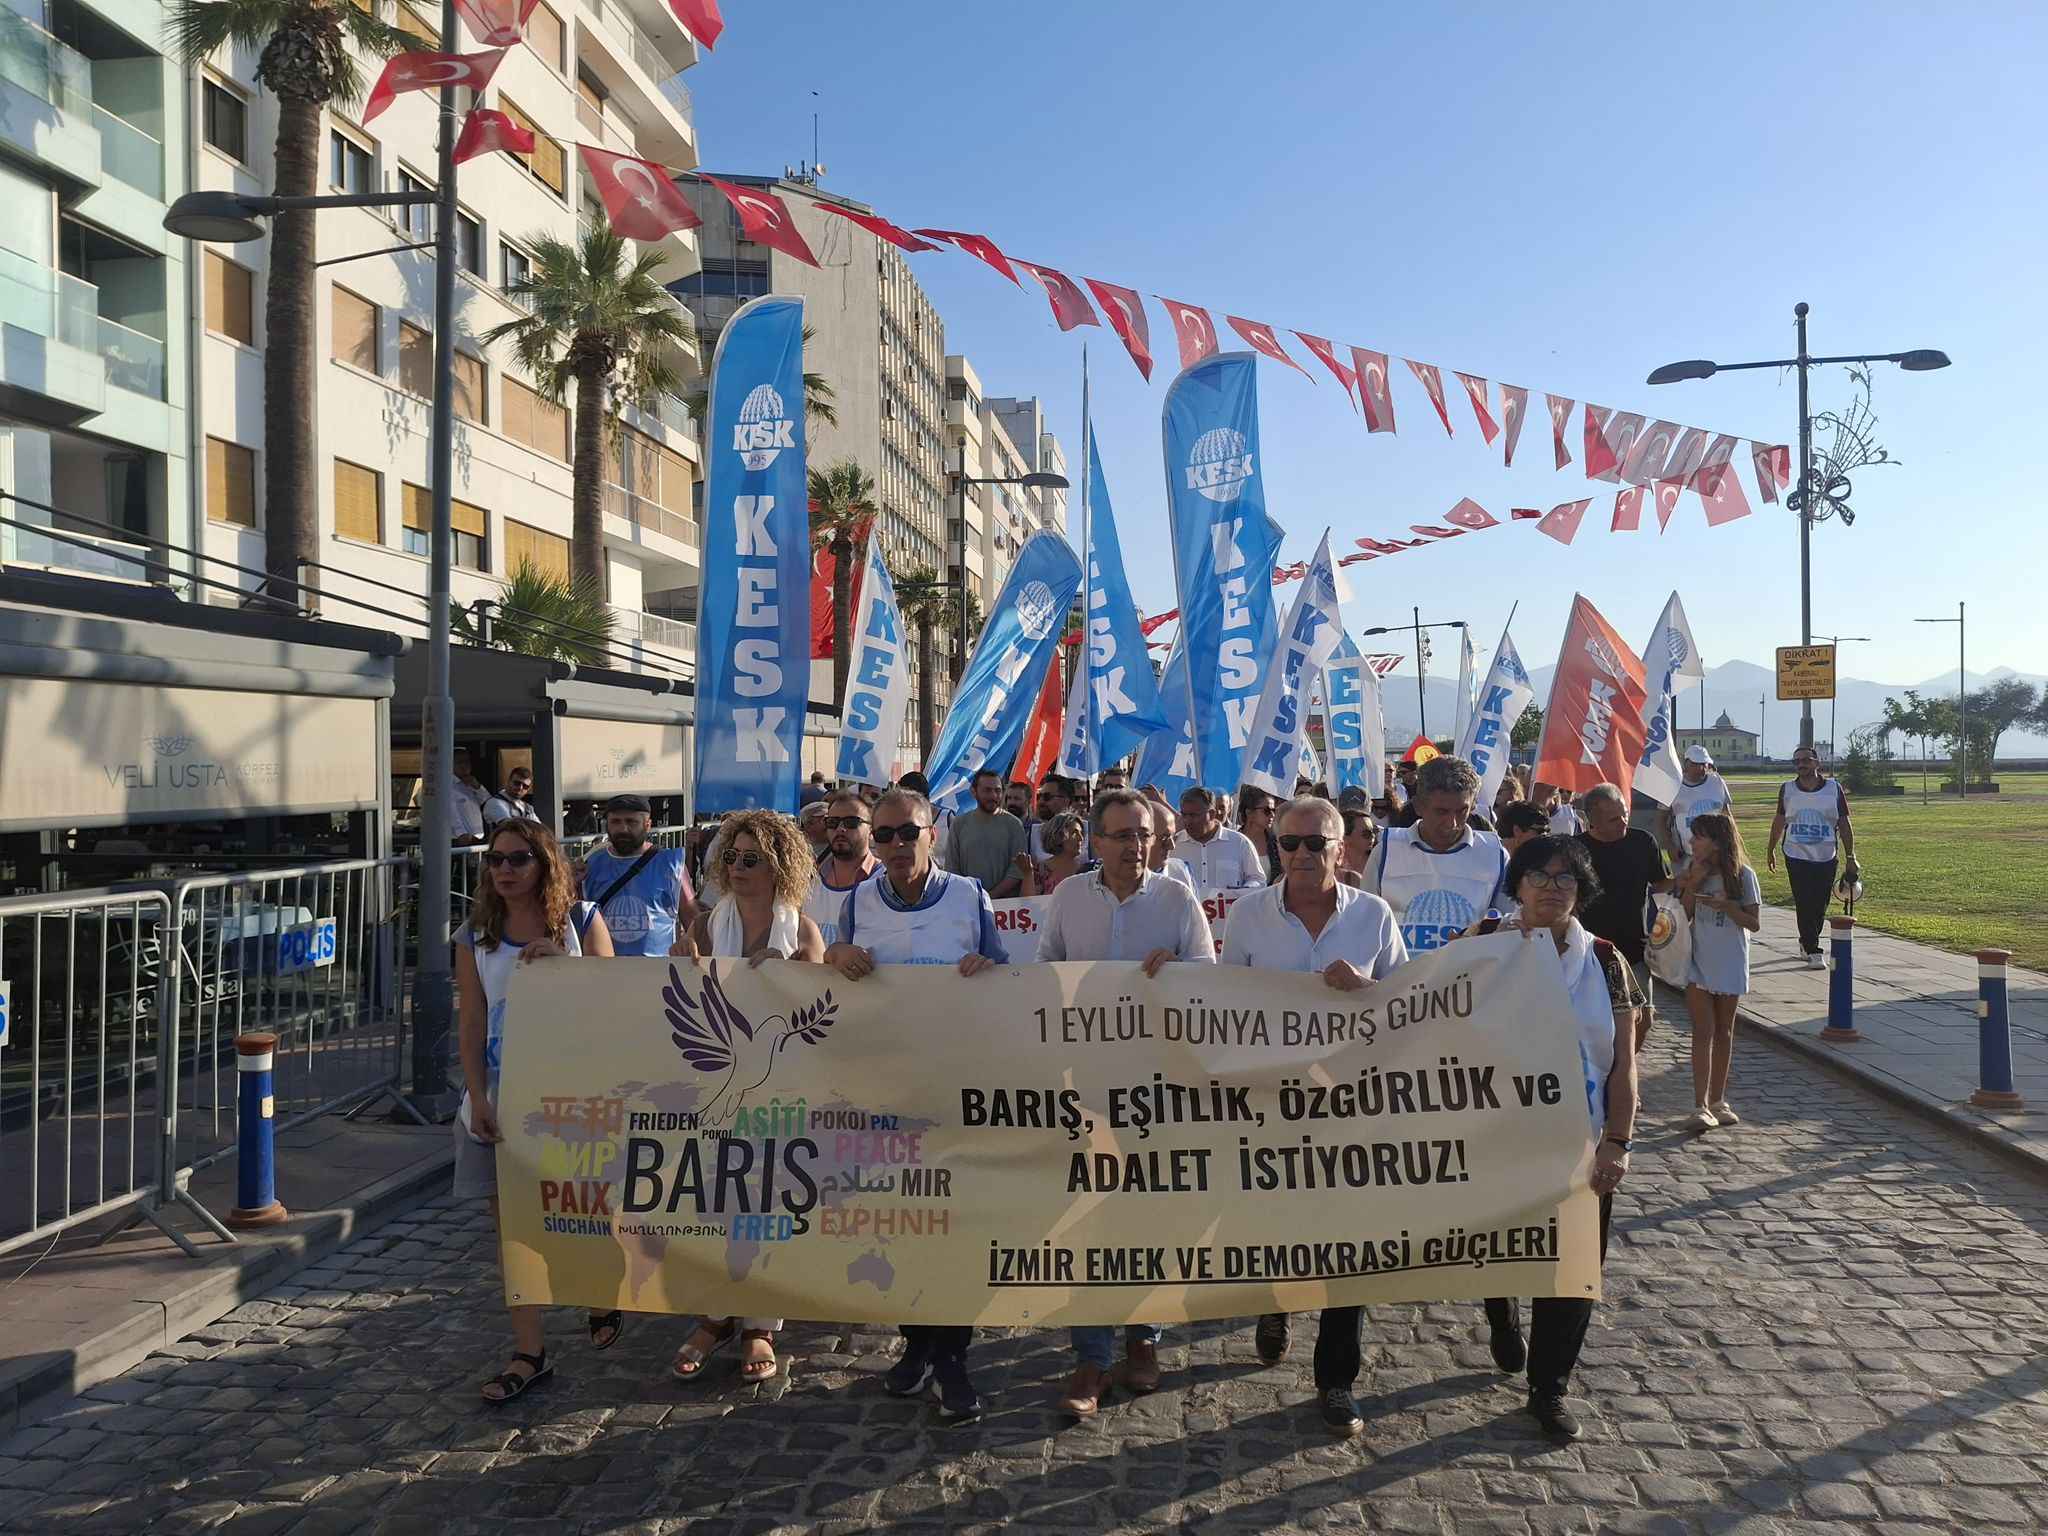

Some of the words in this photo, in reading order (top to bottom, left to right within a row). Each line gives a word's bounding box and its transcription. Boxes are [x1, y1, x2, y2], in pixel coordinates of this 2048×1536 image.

[734, 495, 789, 762] KESK
[1211, 517, 1260, 749] KESK
[837, 598, 897, 777] KESK
[1252, 602, 1329, 779] KESK
[1470, 684, 1513, 777] KES
[104, 760, 158, 788] VELİ
[169, 764, 230, 788] USTA
[994, 908, 1038, 934] RIŞ,
[1402, 924, 1462, 950] KES
[1033, 1008, 1047, 1042] 1
[1062, 996, 1153, 1042] EYLÜL
[1164, 998, 1270, 1046] DÜNYA
[1282, 1009, 1377, 1045] BARIŞ
[1387, 974, 1473, 1029] GÜNÜ
[961, 1088, 1094, 1140] BARIŞ,
[1108, 1073, 1265, 1139] EŞİTLİK,
[1279, 1057, 1501, 1121] ÖZGÜRLÜK
[1513, 1073, 1562, 1107] ve
[629, 1112, 699, 1131] FRIEDEN
[702, 1129, 732, 1140] POKOJ
[811, 1110, 867, 1130] POKOJ
[871, 1115, 900, 1130] PAZ
[836, 1134, 922, 1165] PEACE
[1066, 1149, 1212, 1193] ADALET
[1237, 1135, 1469, 1190] İSTİYORUZ!
[540, 1180, 614, 1216] PAIX
[623, 1137, 819, 1235] BARIŞ
[901, 1168, 952, 1197] MIR
[732, 1214, 793, 1241] FRED
[990, 1240, 1074, 1282] İZMİR
[1086, 1248, 1166, 1281] EMEK
[1176, 1247, 1213, 1280] VE
[1224, 1230, 1411, 1278] DEMOKRASİ
[1423, 1217, 1558, 1268] GÜÇLERİ
